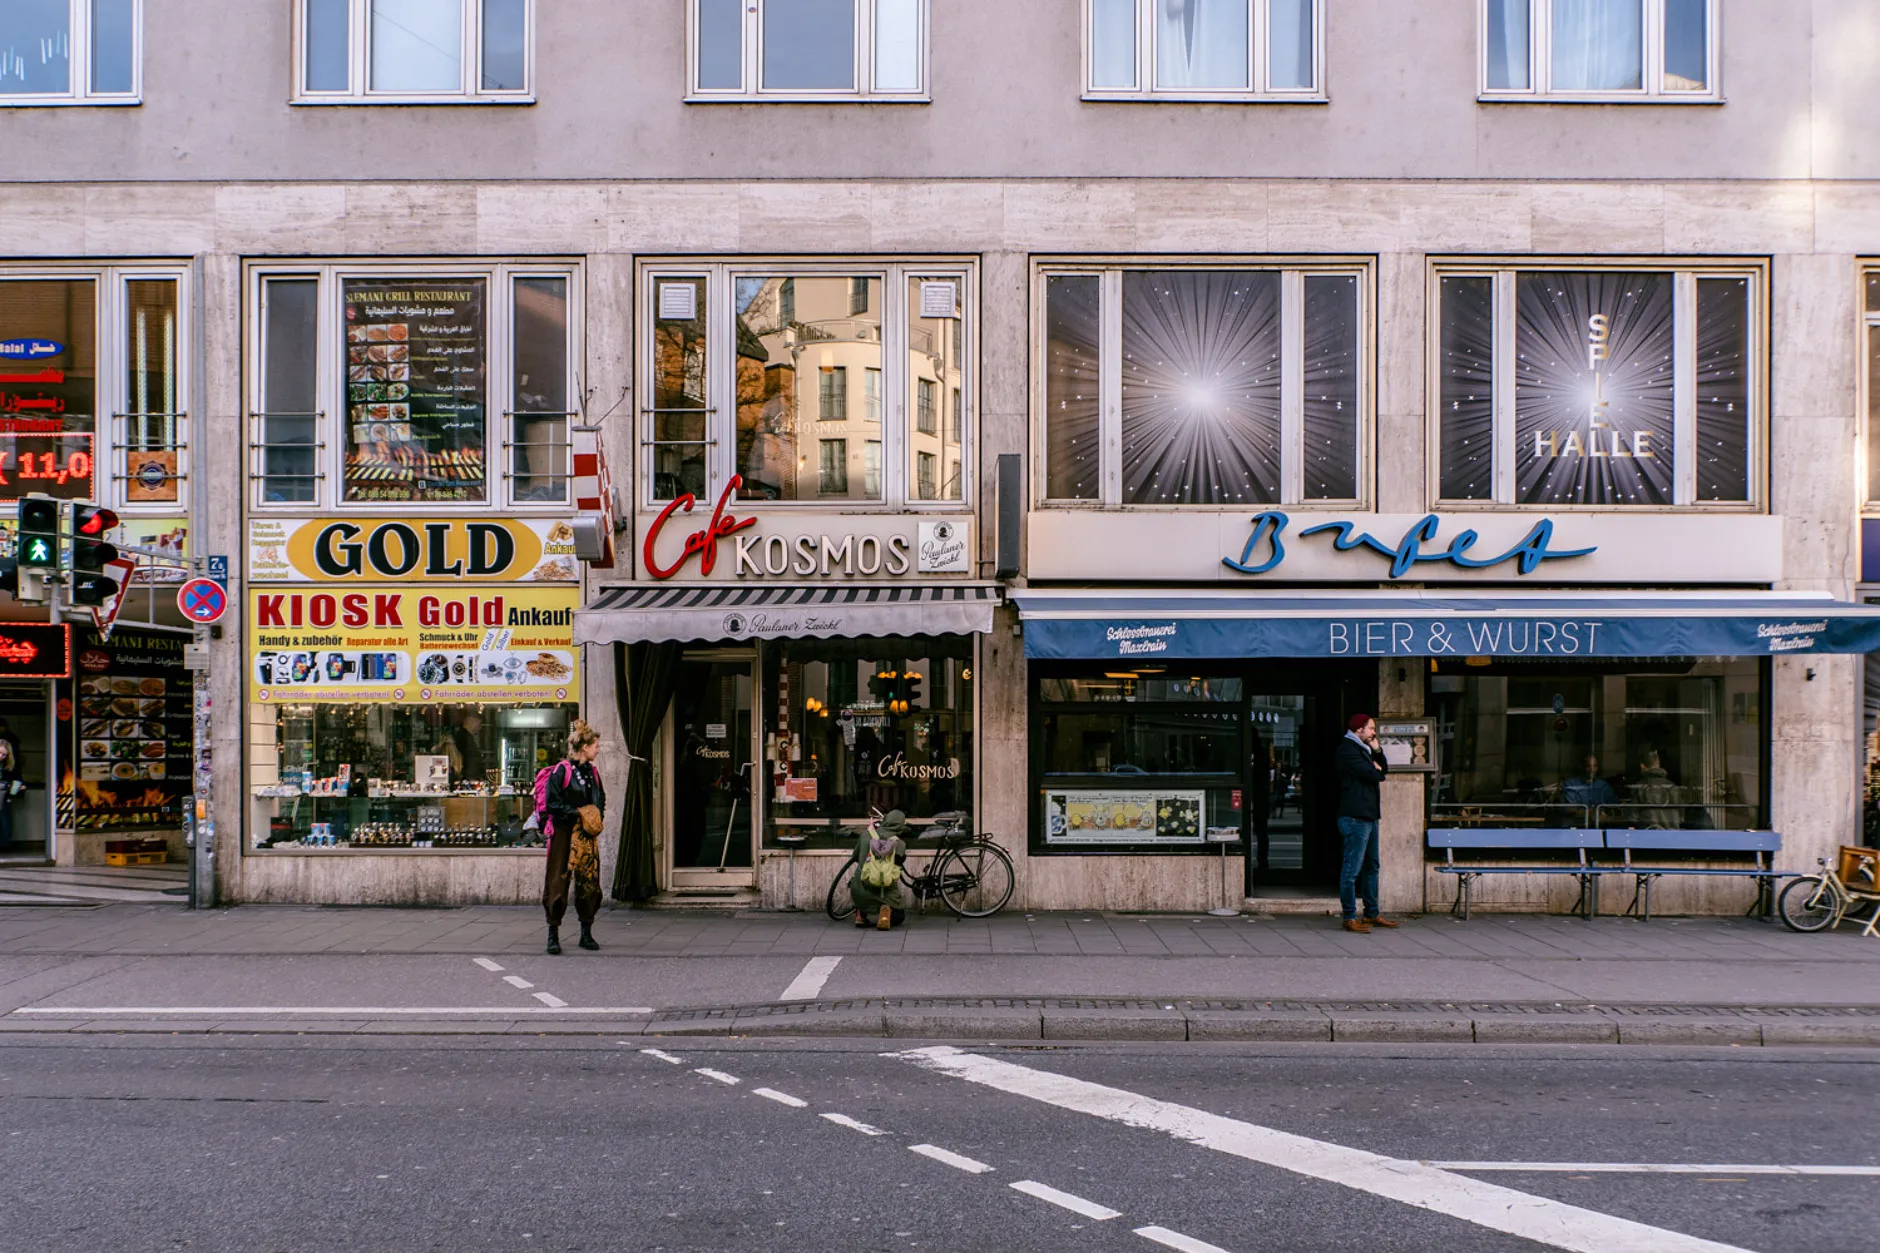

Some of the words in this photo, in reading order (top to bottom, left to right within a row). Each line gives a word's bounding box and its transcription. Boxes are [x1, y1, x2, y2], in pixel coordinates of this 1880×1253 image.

[385, 291, 411, 301] GRILL
[414, 291, 472, 301] RESTAURANT
[1534, 430, 1655, 457] HALLE
[314, 522, 515, 577] GOLD
[544, 542, 576, 555] Ankau
[734, 534, 910, 577] KOSMOS
[921, 541, 965, 561] Paulaner
[256, 594, 404, 629] KIOSK
[418, 595, 505, 628] Gold
[508, 606, 572, 626] Ankauf
[749, 613, 800, 633] Paulaner
[804, 617, 842, 630] Zwickl
[1106, 622, 1177, 641] Schlossbrauerei
[147, 638, 186, 651] RESTA
[258, 634, 291, 647] Handy
[292, 635, 300, 646] &
[301, 634, 343, 646] zubehör
[346, 638, 382, 647] Reparatur
[383, 637, 397, 646] alle
[397, 637, 409, 646] Art
[419, 632, 456, 642] Schmuck
[457, 633, 463, 642] &
[464, 632, 479, 642] Uhr
[419, 642, 479, 650] Batteriewechsel
[481, 632, 495, 651] Gold
[510, 637, 537, 646] Einkauf
[538, 638, 543, 646] &
[544, 637, 572, 646] Verkauf
[1330, 622, 1414, 654] BIER
[1427, 622, 1456, 654] &
[1467, 622, 1603, 654] WURST
[434, 688, 474, 698] Fahrräder
[475, 688, 513, 698] abstellen
[514, 688, 552, 698] verboten!
[878, 752, 907, 778] Cafe
[900, 765, 956, 779] KOSMOS
